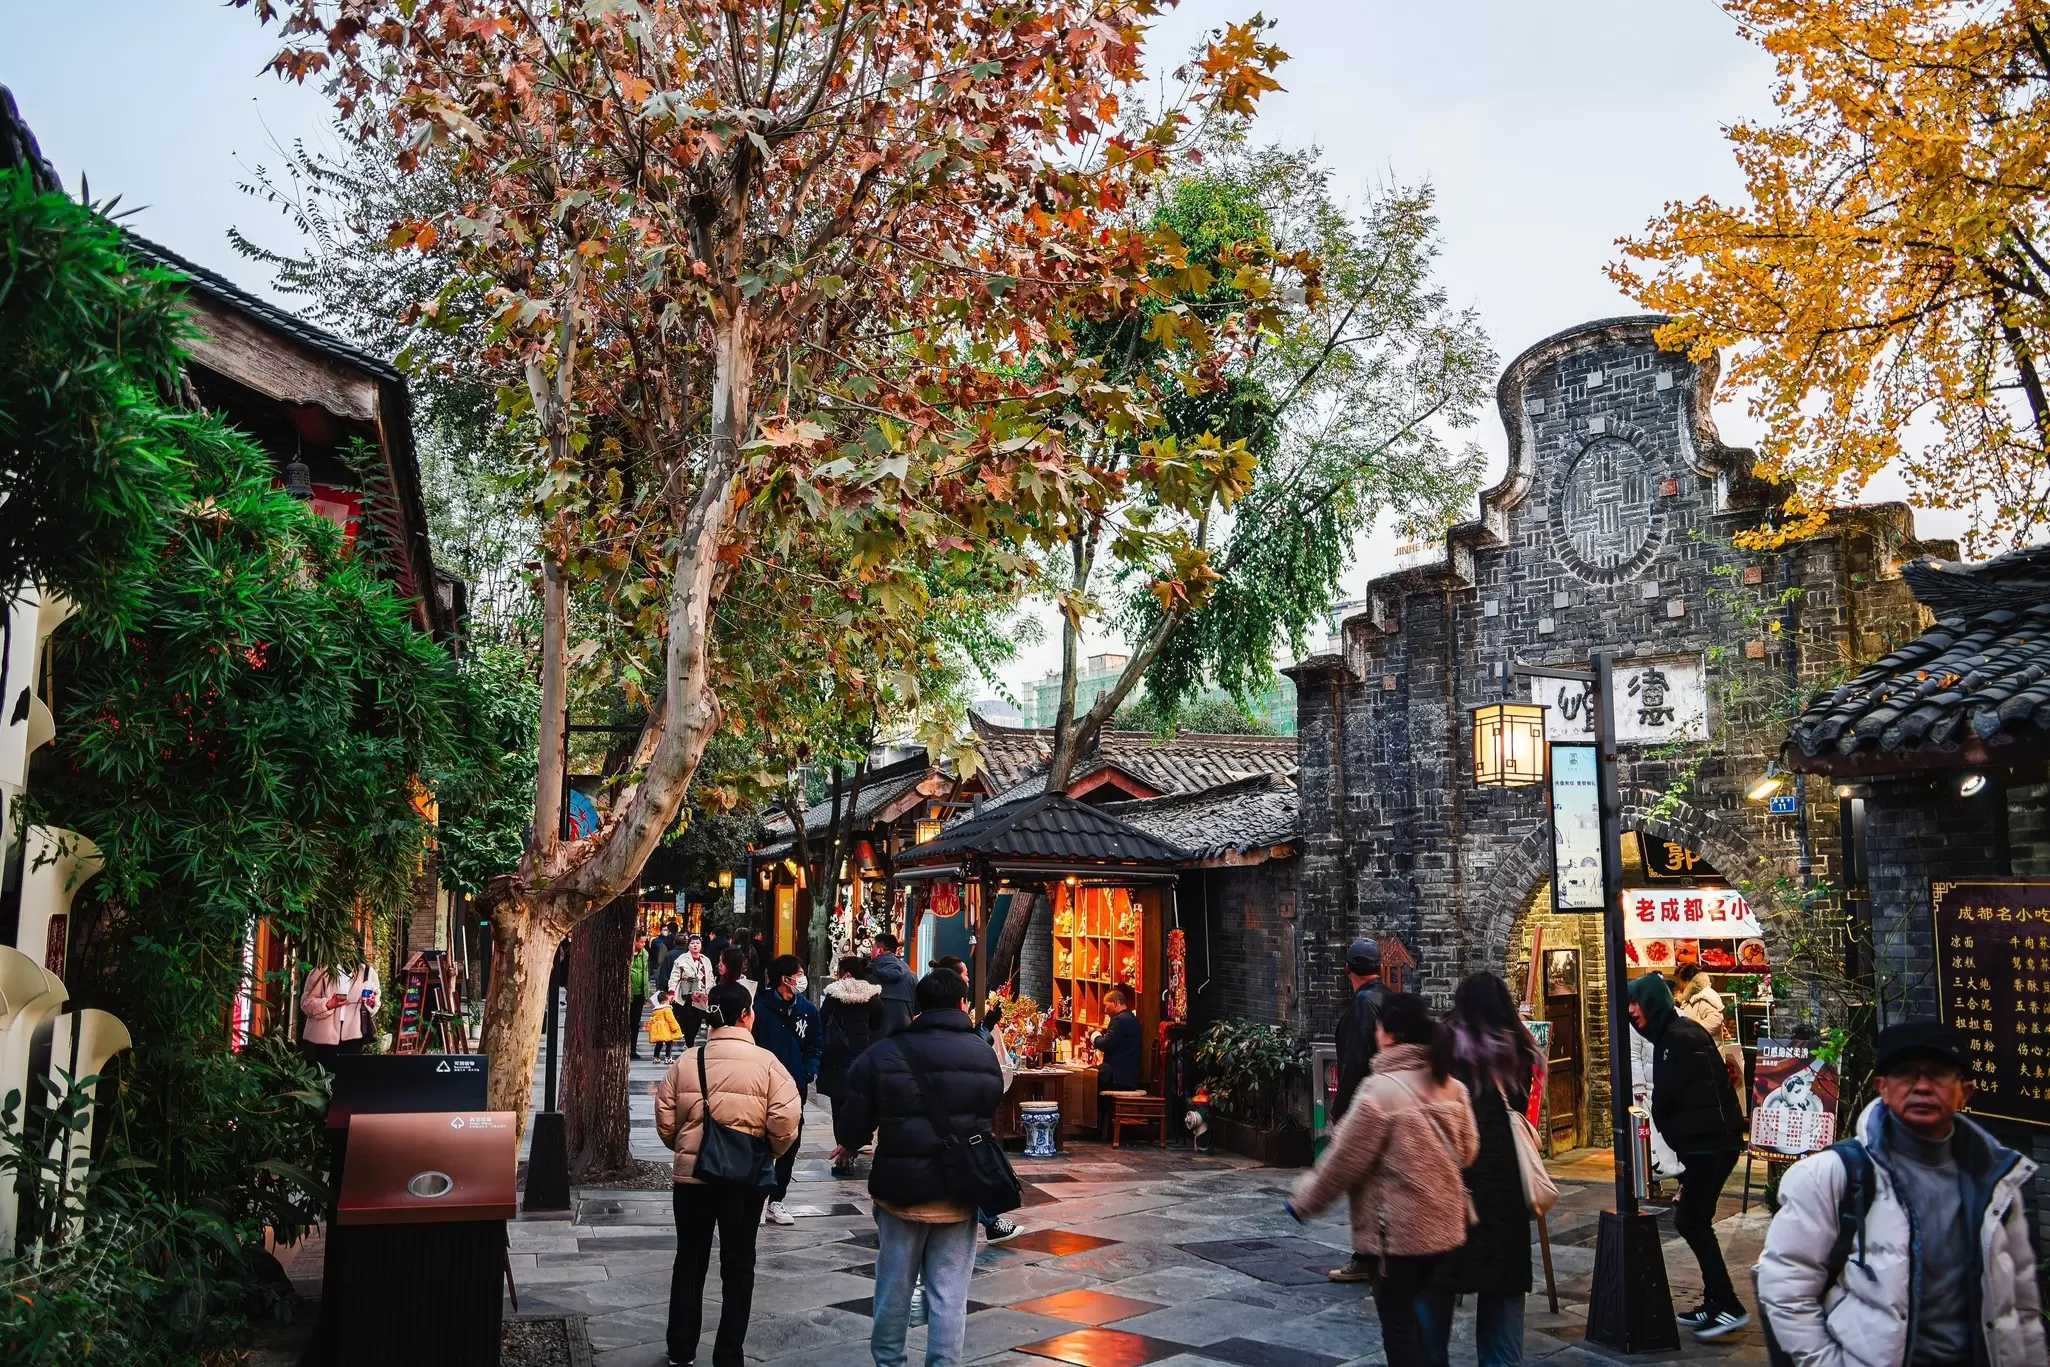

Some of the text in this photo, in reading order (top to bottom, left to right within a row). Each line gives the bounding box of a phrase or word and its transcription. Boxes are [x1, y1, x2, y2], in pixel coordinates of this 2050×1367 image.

[1778, 802, 1787, 810] 11
[1635, 897, 1751, 922] 老成都名小
[1958, 906, 2050, 922] 成都名小吃
[1951, 935, 1974, 948] 凉面
[1953, 976, 1991, 991] 三大炮
[2020, 1063, 2050, 1078] 夫妻
